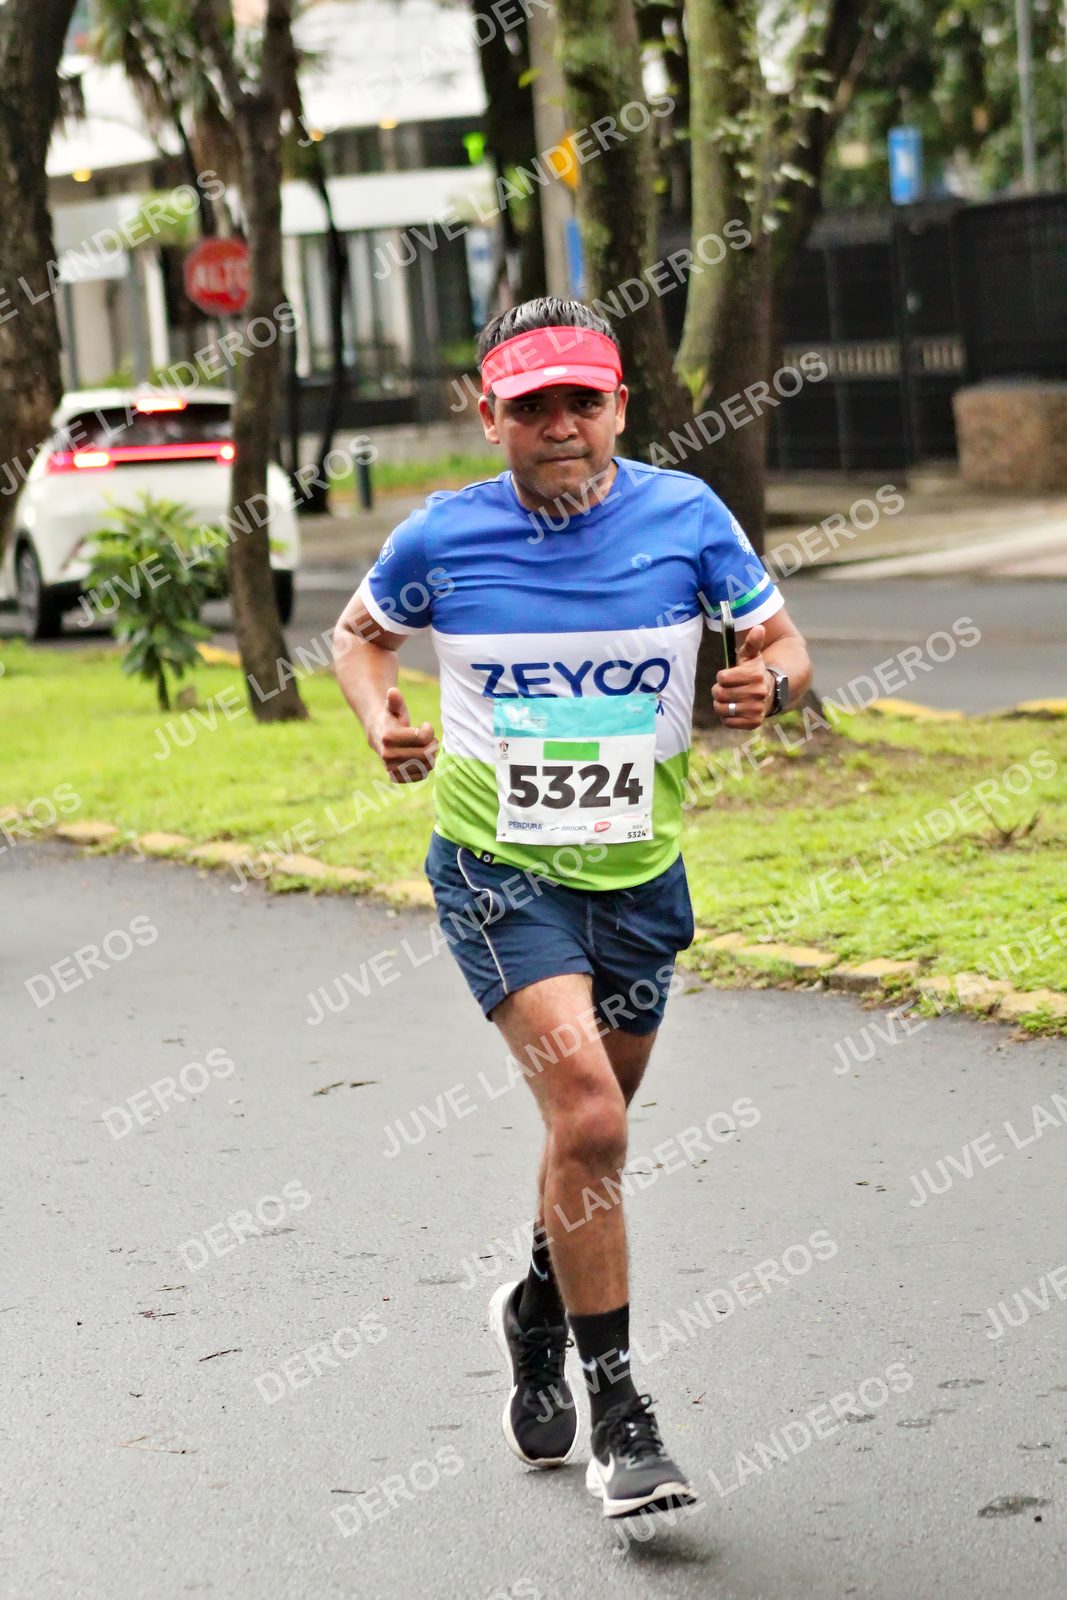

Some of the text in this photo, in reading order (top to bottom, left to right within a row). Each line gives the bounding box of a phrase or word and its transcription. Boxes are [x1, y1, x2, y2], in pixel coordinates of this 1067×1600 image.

[471, 658, 670, 698] ZEYCO
[507, 763, 643, 809] 5324
[508, 821, 543, 830] PERDURA
[627, 831, 646, 839] 5324
